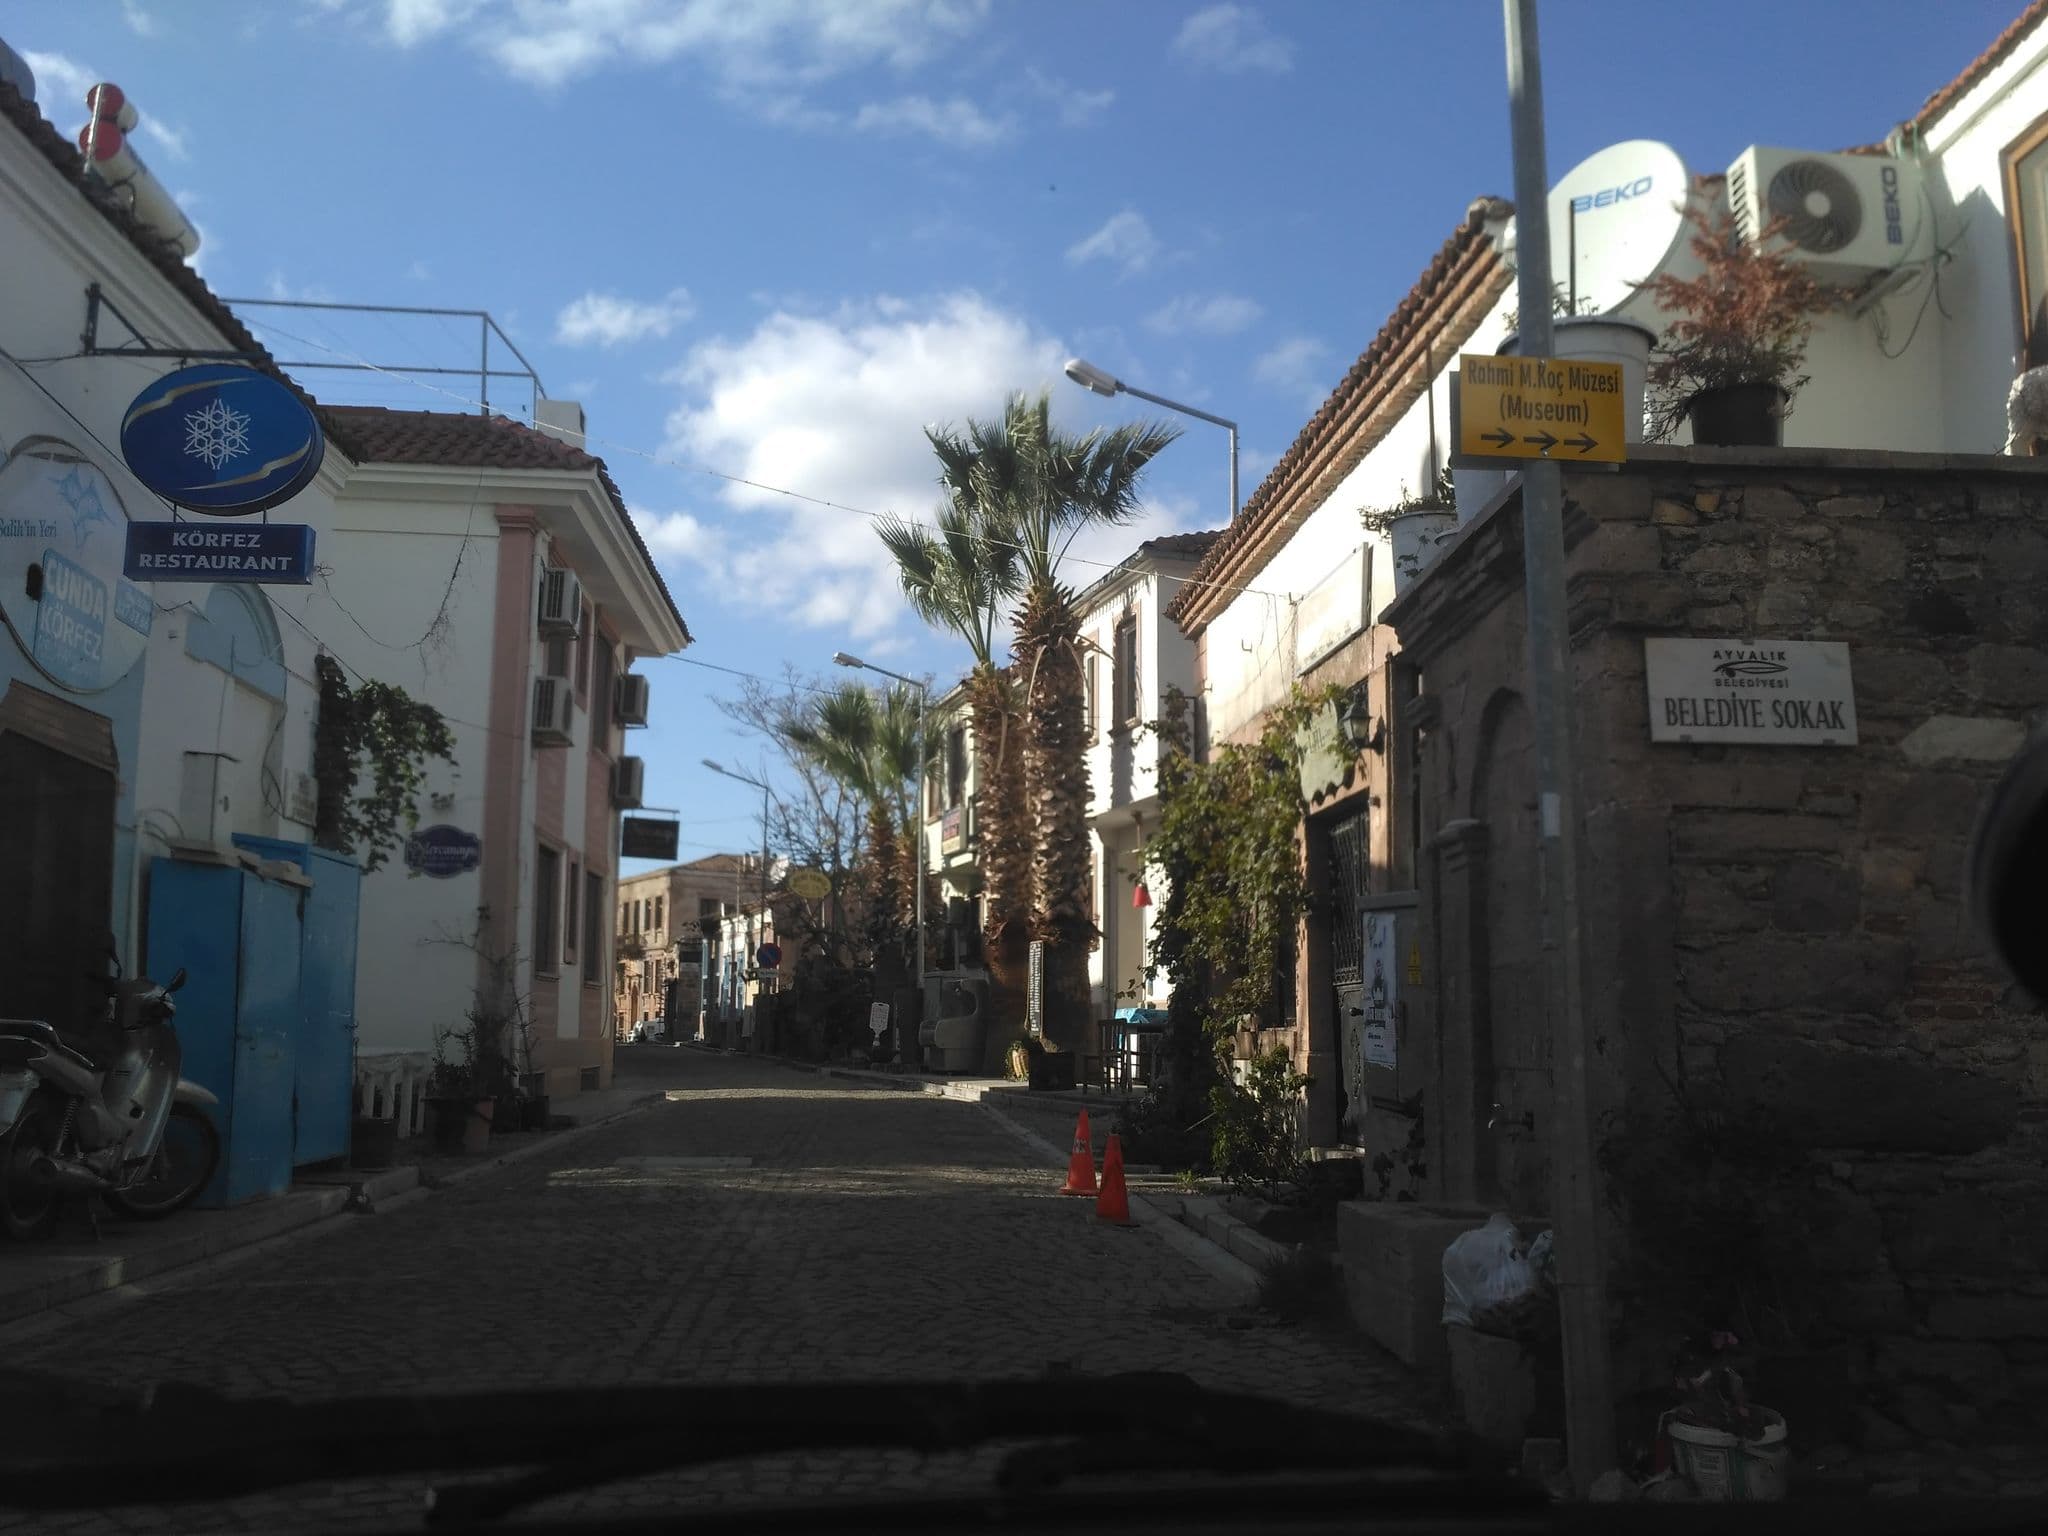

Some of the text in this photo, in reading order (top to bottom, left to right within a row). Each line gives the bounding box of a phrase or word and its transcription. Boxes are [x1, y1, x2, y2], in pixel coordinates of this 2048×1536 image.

[1570, 174, 1652, 213] BEKO
[1881, 166, 1903, 245] BEKO
[1468, 359, 1513, 387] Rahmi
[1568, 366, 1619, 394] Müzesi
[1500, 392, 1589, 426] (Museum)
[173, 530, 261, 548] KÖRFEZ
[138, 553, 292, 571] RESTAURANT
[45, 557, 104, 625] CUNDA
[40, 600, 102, 659] KÖRFEZ
[1713, 650, 1787, 661] AYVALIK
[1715, 677, 1790, 689] BELEDİYESİ
[1664, 691, 1846, 729] BELEDİYE SOKAK
